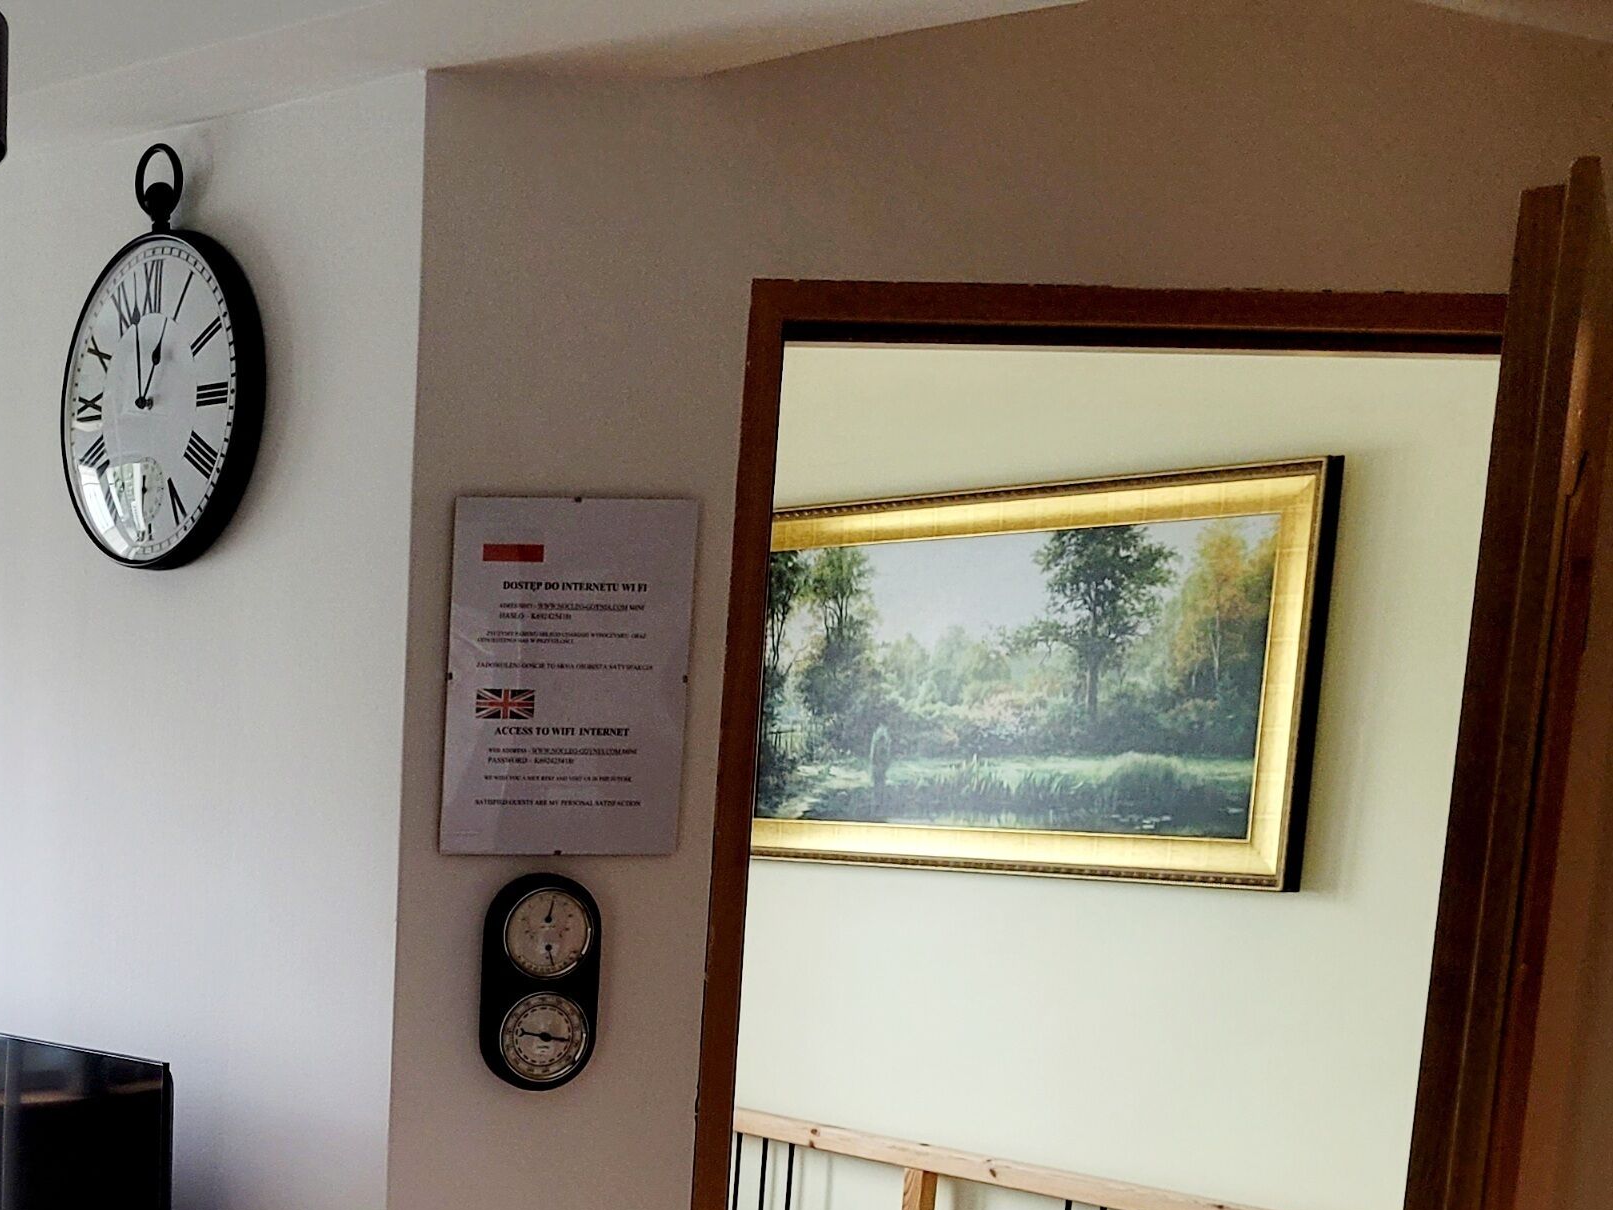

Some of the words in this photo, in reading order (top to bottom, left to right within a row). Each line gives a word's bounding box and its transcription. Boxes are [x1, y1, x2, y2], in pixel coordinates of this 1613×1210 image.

[143, 259, 165, 317] XII
[196, 381, 229, 408] III
[503, 581, 543, 593] DOSTĘP
[544, 581, 560, 591] DO
[561, 582, 619, 592] INTERNETU
[494, 726, 534, 736] ACCESS
[535, 726, 550, 736] TO
[551, 727, 576, 736] WIFI
[579, 727, 630, 737] INTERNET
